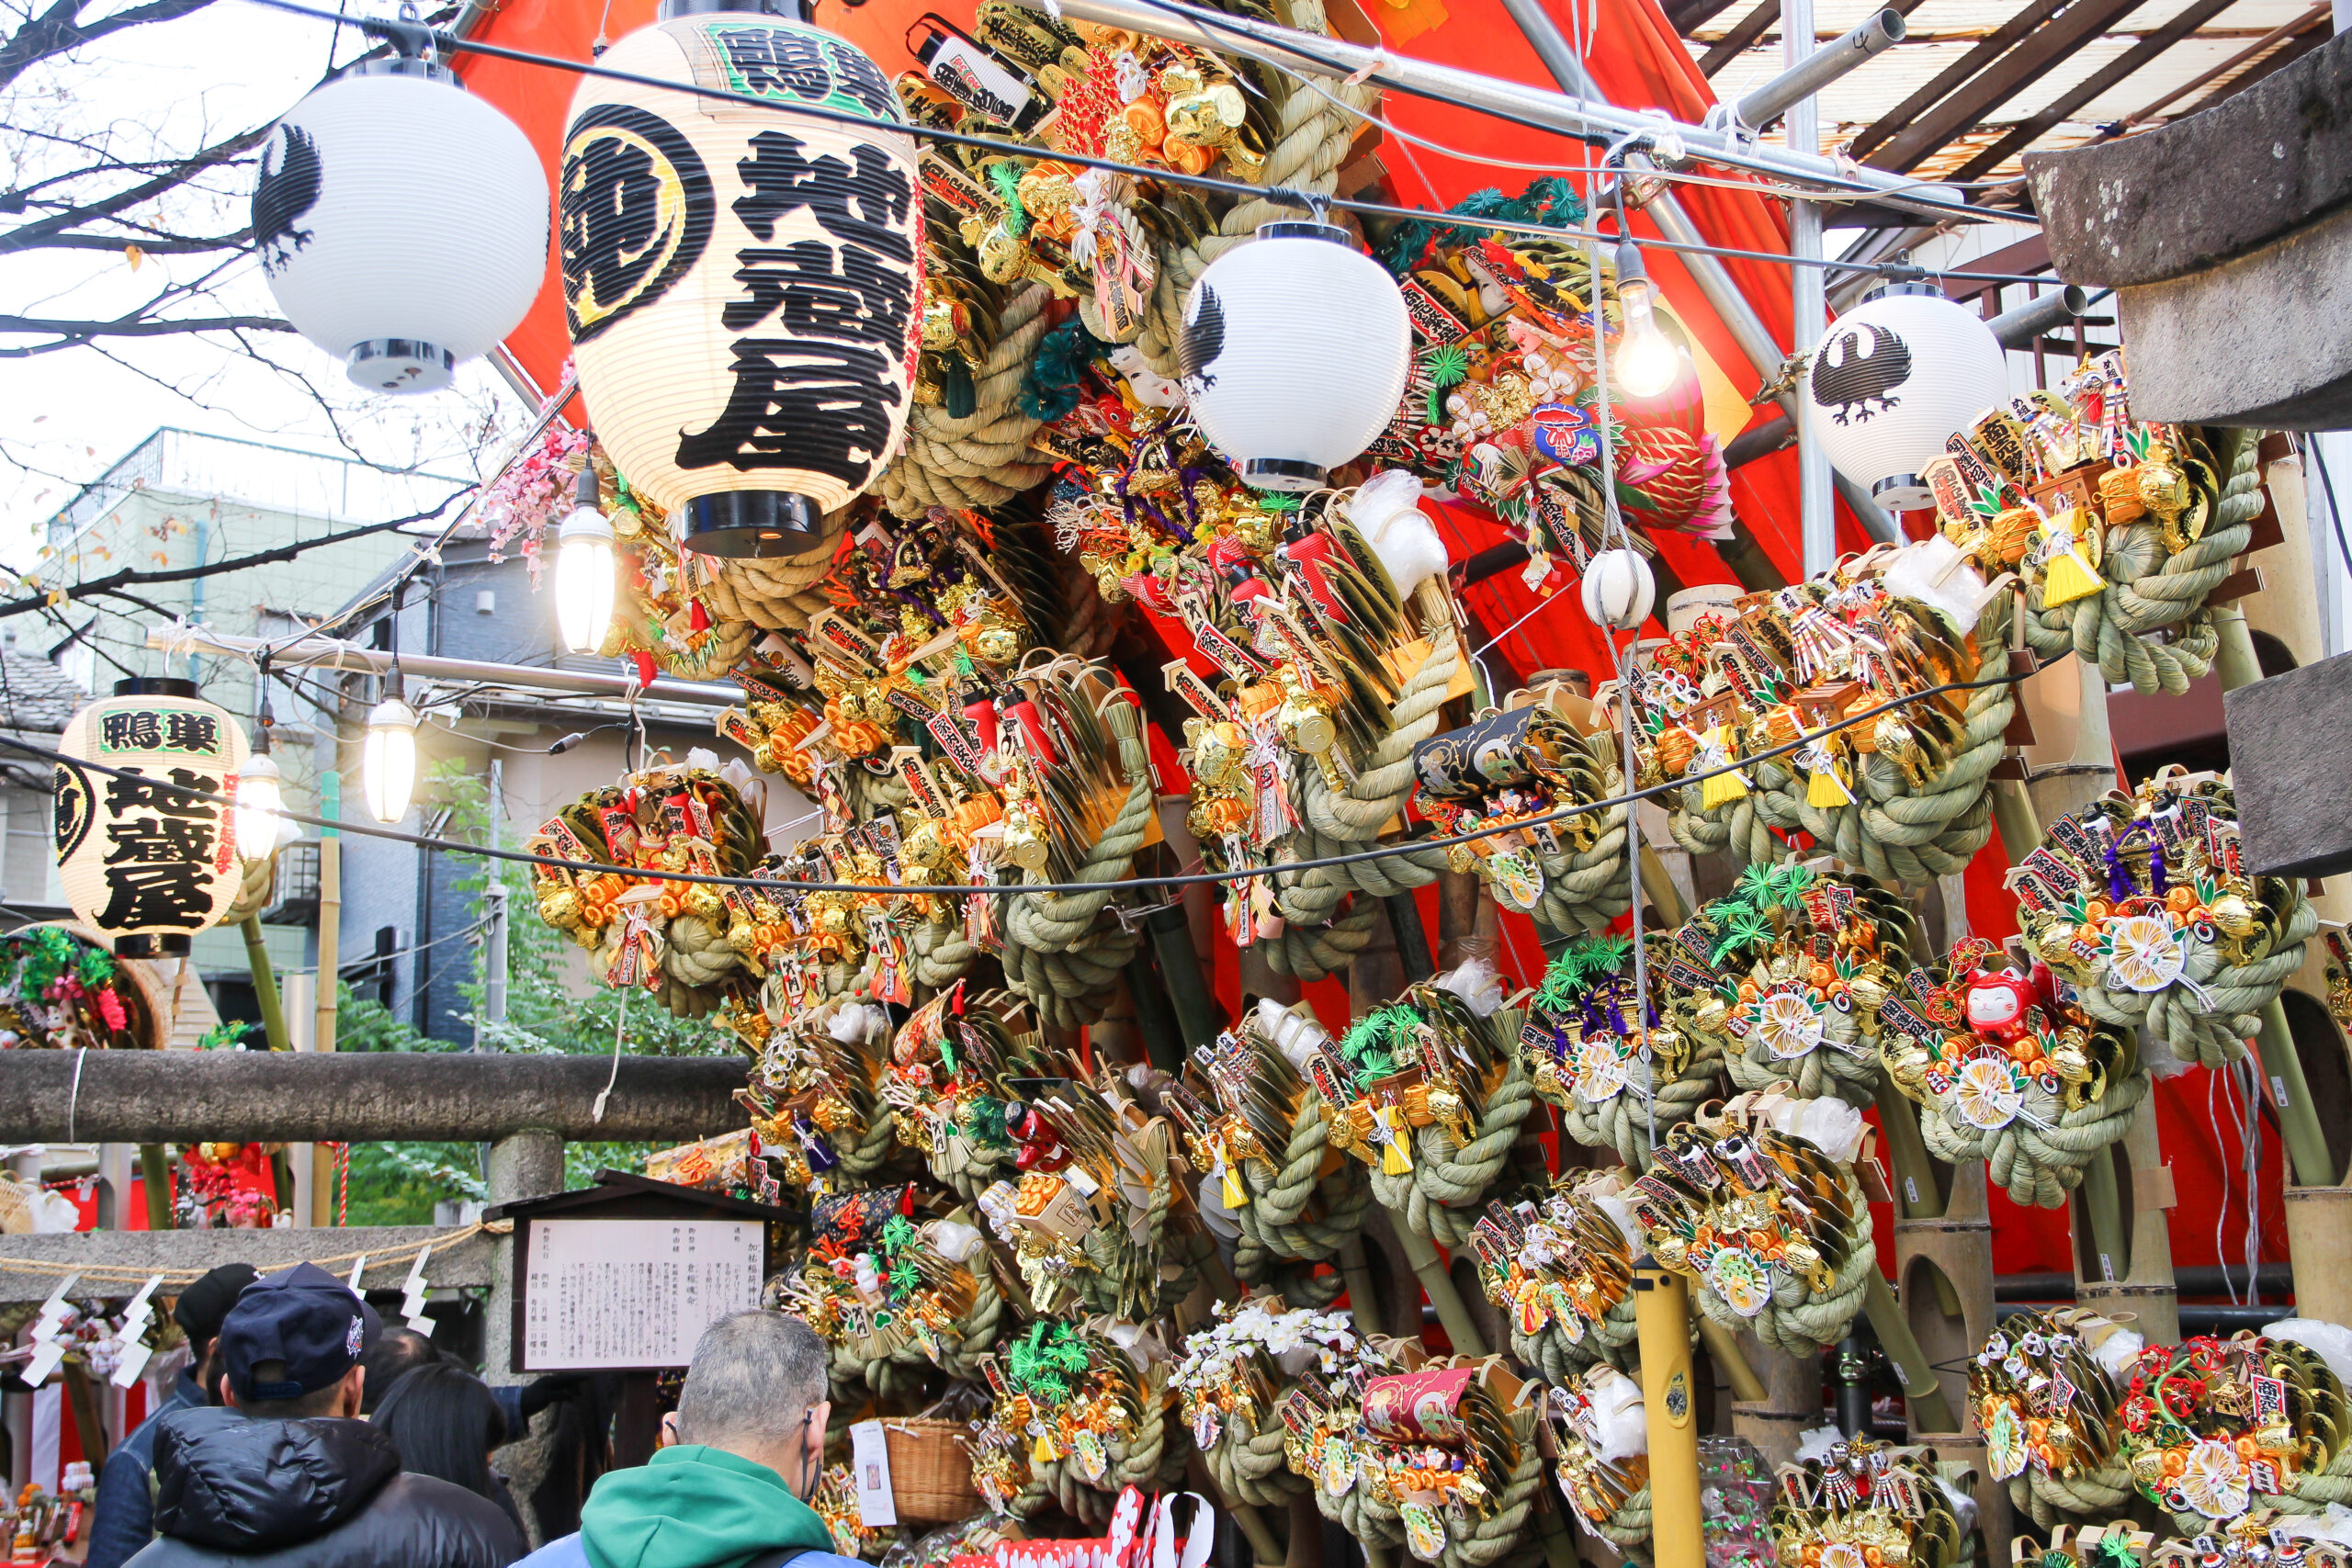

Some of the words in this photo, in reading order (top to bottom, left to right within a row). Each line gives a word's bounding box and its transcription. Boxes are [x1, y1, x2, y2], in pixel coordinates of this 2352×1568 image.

[918, 156, 1002, 230] 商売繁昌
[674, 130, 913, 490] 地蔵屋
[1396, 285, 1461, 346] 商売繁盛
[2101, 358, 2117, 379] め組
[2009, 396, 2030, 418] め組
[933, 717, 979, 773] 家内安全
[898, 755, 949, 821] 商売繁昌
[92, 766, 220, 930] 地蔵屋
[1533, 823, 1556, 855] 笑門
[869, 919, 890, 953] 笑門
[782, 959, 799, 993] 笑門
[1881, 998, 1930, 1046] 開運招
[1310, 1057, 1345, 1111] 商売繁昌
[930, 1121, 946, 1150] 笑門
[851, 1305, 868, 1335] 笑門
